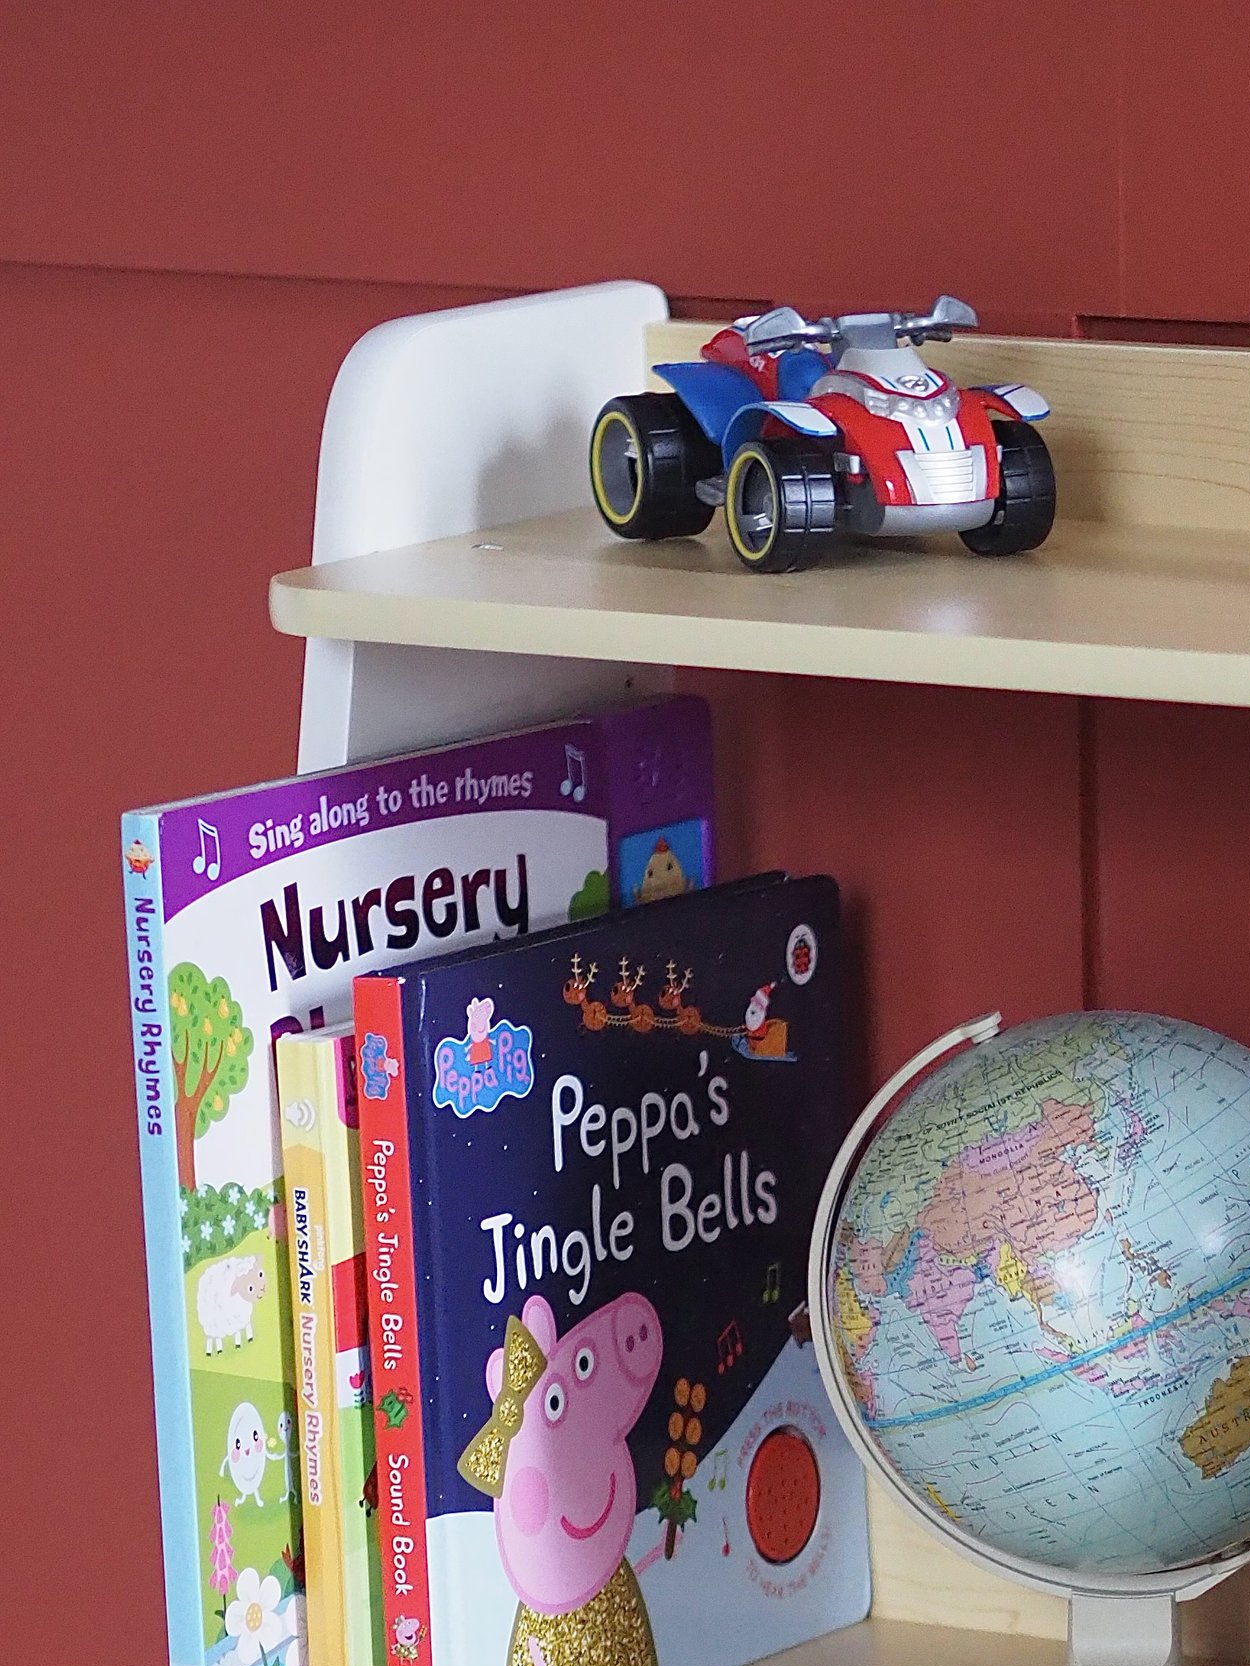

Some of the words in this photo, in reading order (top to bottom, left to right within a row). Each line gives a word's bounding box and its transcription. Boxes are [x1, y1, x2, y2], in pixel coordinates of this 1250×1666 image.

[248, 813, 304, 859] Sing
[310, 796, 369, 835] along
[376, 786, 402, 815] to
[409, 774, 448, 808] the
[455, 768, 534, 805] rhymes
[134, 898, 156, 1013] Nursery
[260, 854, 529, 992] Nursery
[138, 1024, 162, 1136] Rhymes
[438, 1046, 498, 1109] Peppa
[499, 1031, 531, 1083] Pig
[553, 1050, 730, 1190] Peppa's
[294, 1189, 308, 1234] BABY
[366, 1140, 396, 1223] Peppa's
[297, 1234, 315, 1304] SHARK
[373, 1232, 399, 1303] Jingle
[481, 1184, 634, 1305] Jingle
[660, 1150, 778, 1252] Bells
[301, 1314, 315, 1409] Nursery
[381, 1313, 403, 1370] Bells
[306, 1412, 320, 1504] Rhymes
[388, 1453, 410, 1527] Sound
[392, 1536, 414, 1596] Book
